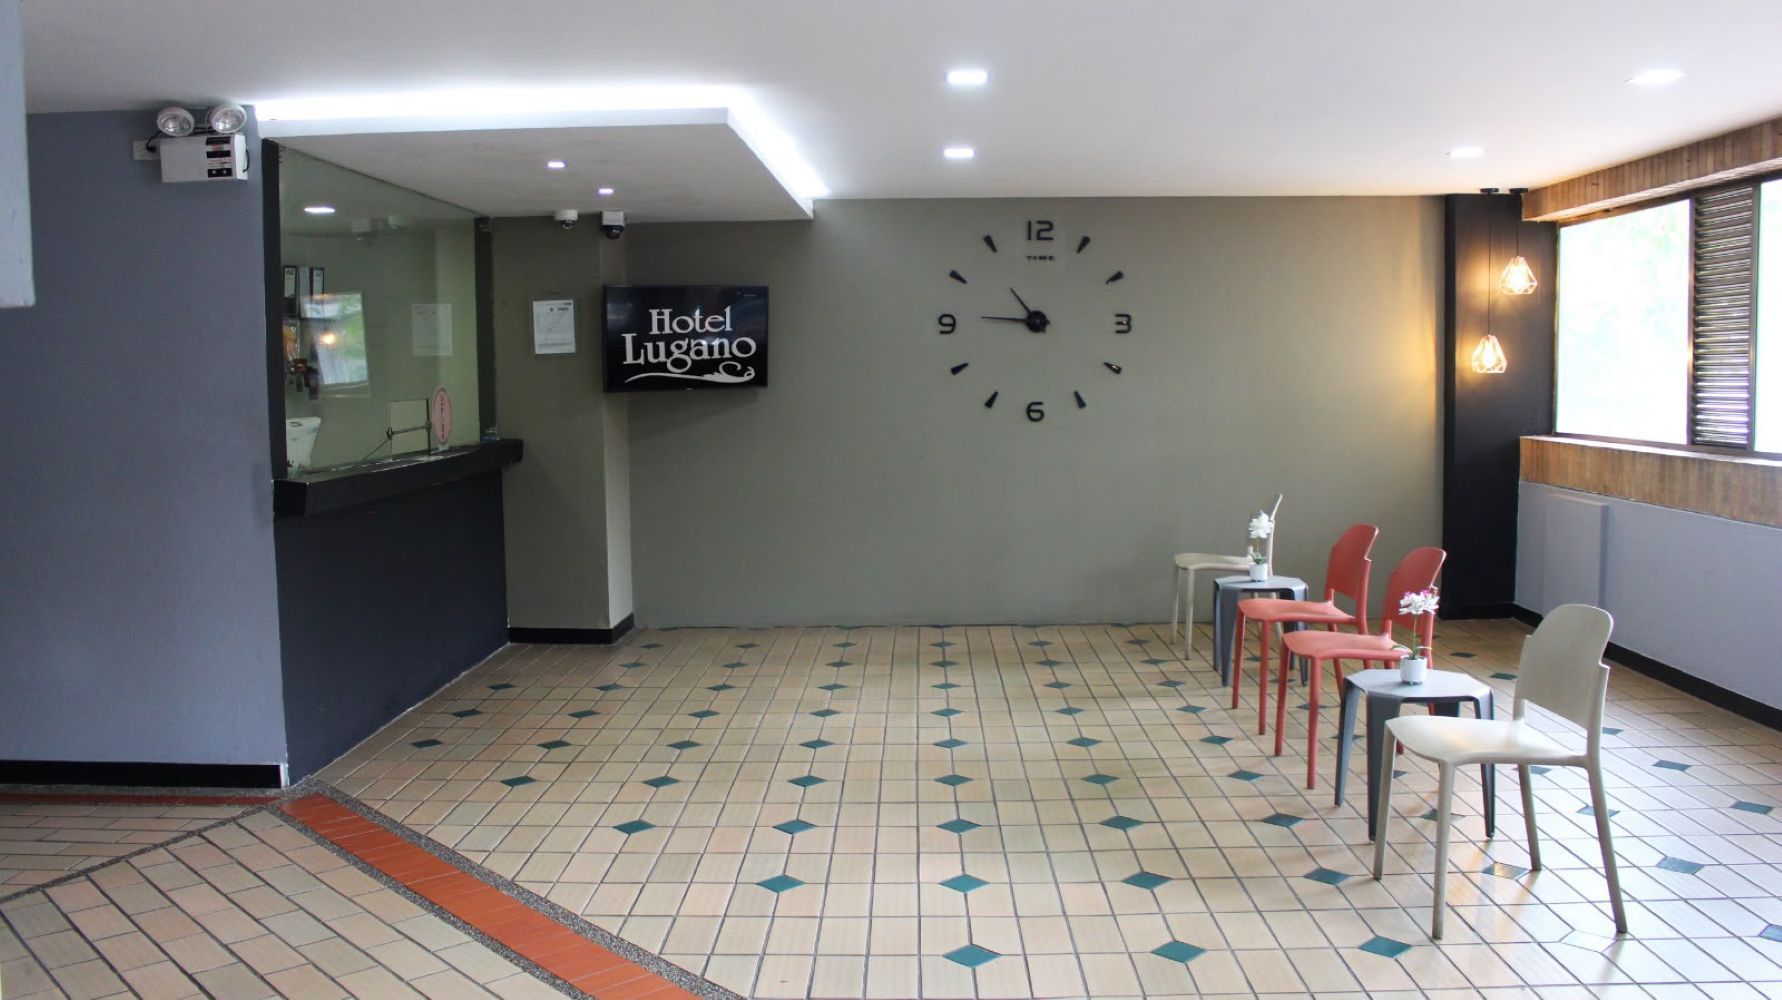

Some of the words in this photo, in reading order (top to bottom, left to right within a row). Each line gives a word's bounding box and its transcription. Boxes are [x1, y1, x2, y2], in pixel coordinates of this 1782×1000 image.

[1027, 220, 1054, 241] 12
[649, 305, 733, 335] Hotel
[938, 313, 957, 335] 9
[1114, 313, 1132, 334] 3
[621, 333, 757, 373] Lugano
[1026, 401, 1045, 423] 6
